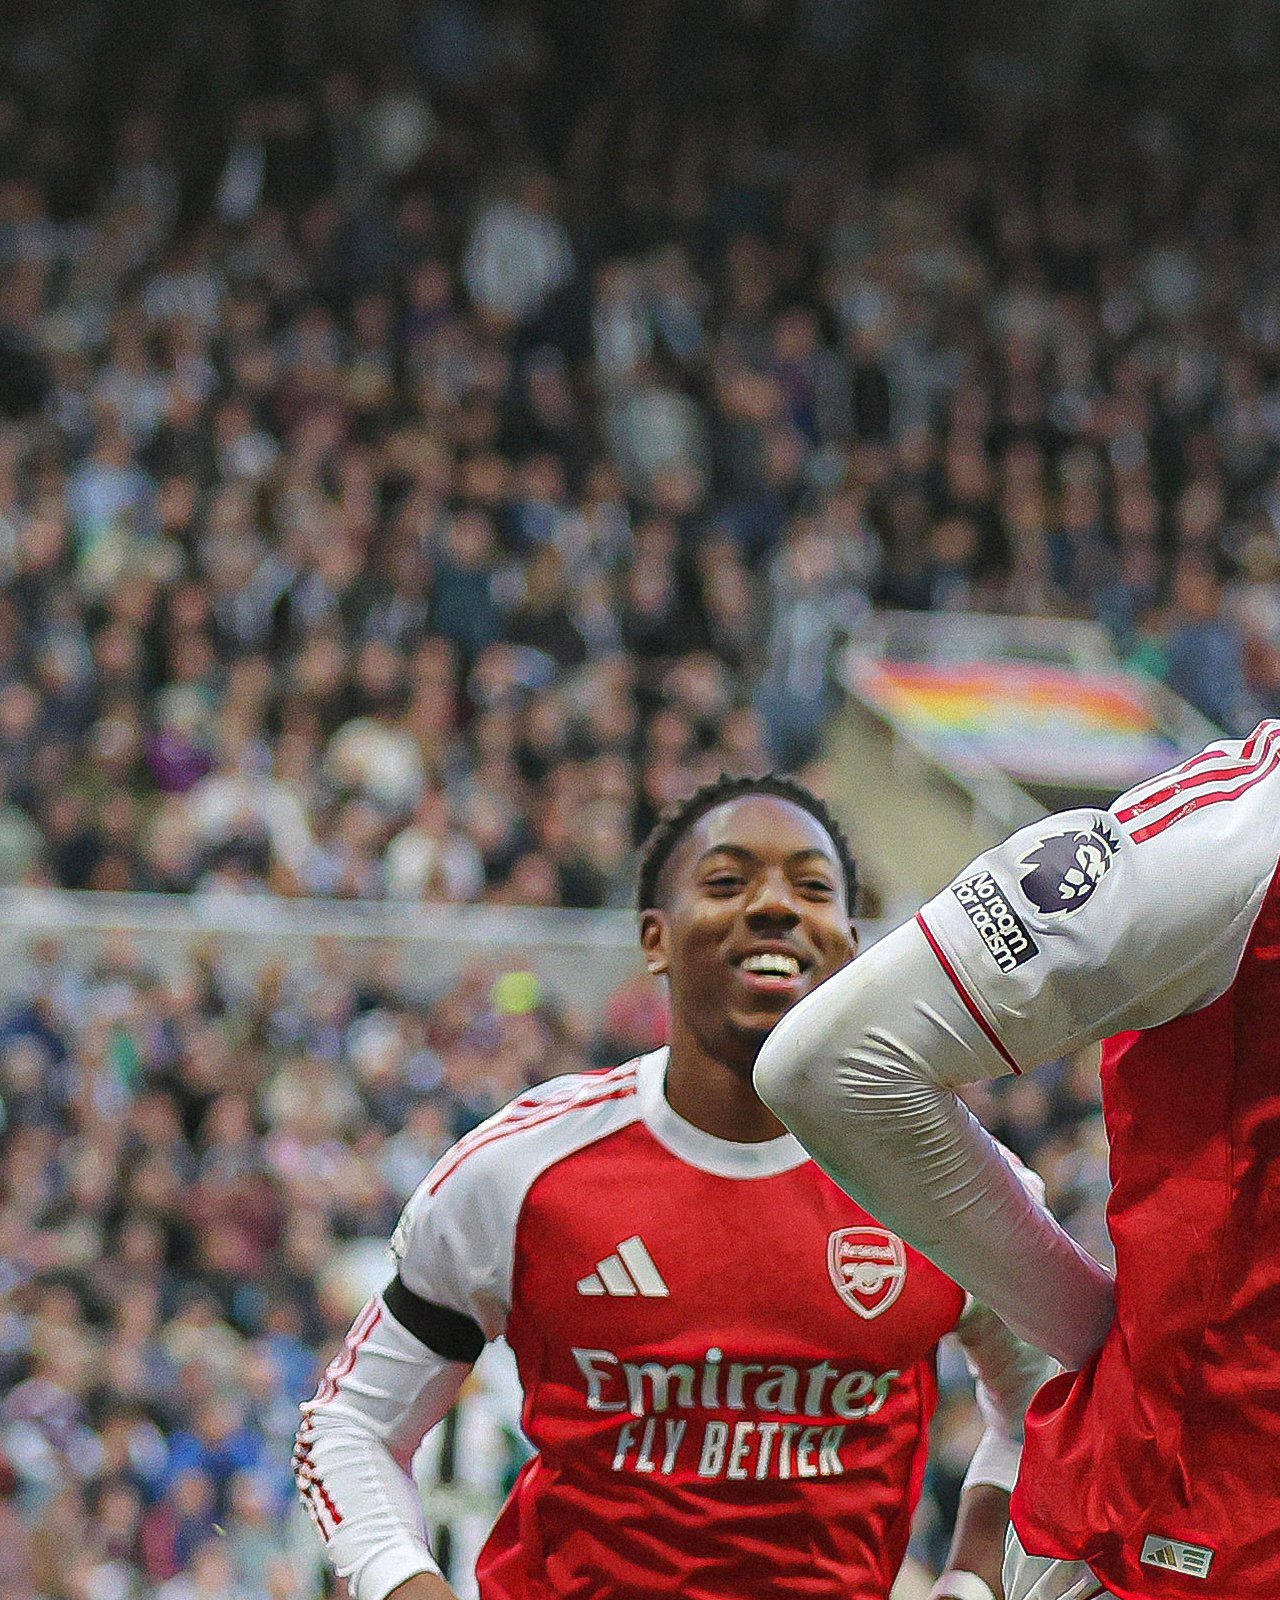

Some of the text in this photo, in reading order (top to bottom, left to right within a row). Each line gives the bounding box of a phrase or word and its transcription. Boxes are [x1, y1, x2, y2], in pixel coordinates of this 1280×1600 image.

[967, 902, 1018, 974] racism
[971, 871, 1029, 954] No room
[612, 1418, 847, 1481] FLY BETTER
